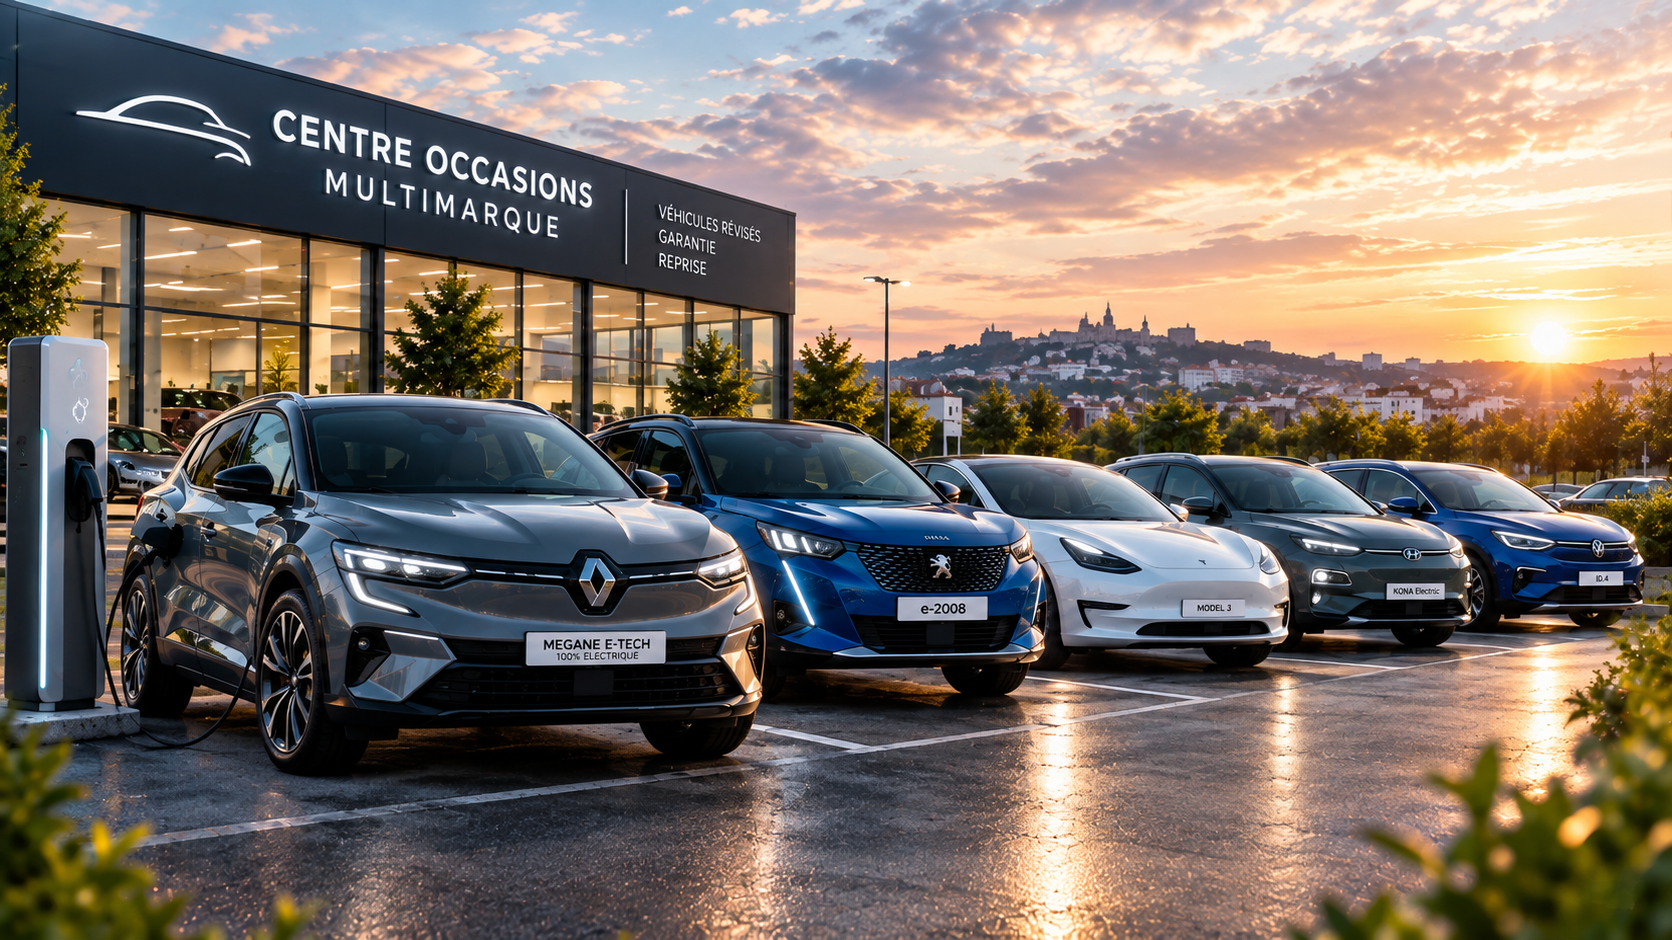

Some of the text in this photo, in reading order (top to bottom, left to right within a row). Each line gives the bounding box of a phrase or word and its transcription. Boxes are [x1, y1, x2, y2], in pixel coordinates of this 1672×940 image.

[272, 109, 593, 209] CENTRE OCCASIONS
[325, 168, 559, 239] MULTIMARQUE
[658, 204, 761, 243] VÉHICULES RÉVISÉS
[658, 229, 716, 255] GARANTIE
[658, 252, 707, 276] REPRISE
[1393, 587, 1414, 595] KONA
[920, 603, 966, 614] e-2008
[1197, 604, 1232, 612] MODEL 3
[543, 638, 651, 650] MEGANE E-TECH
[556, 651, 639, 661] 100% ELECTRIQUE
